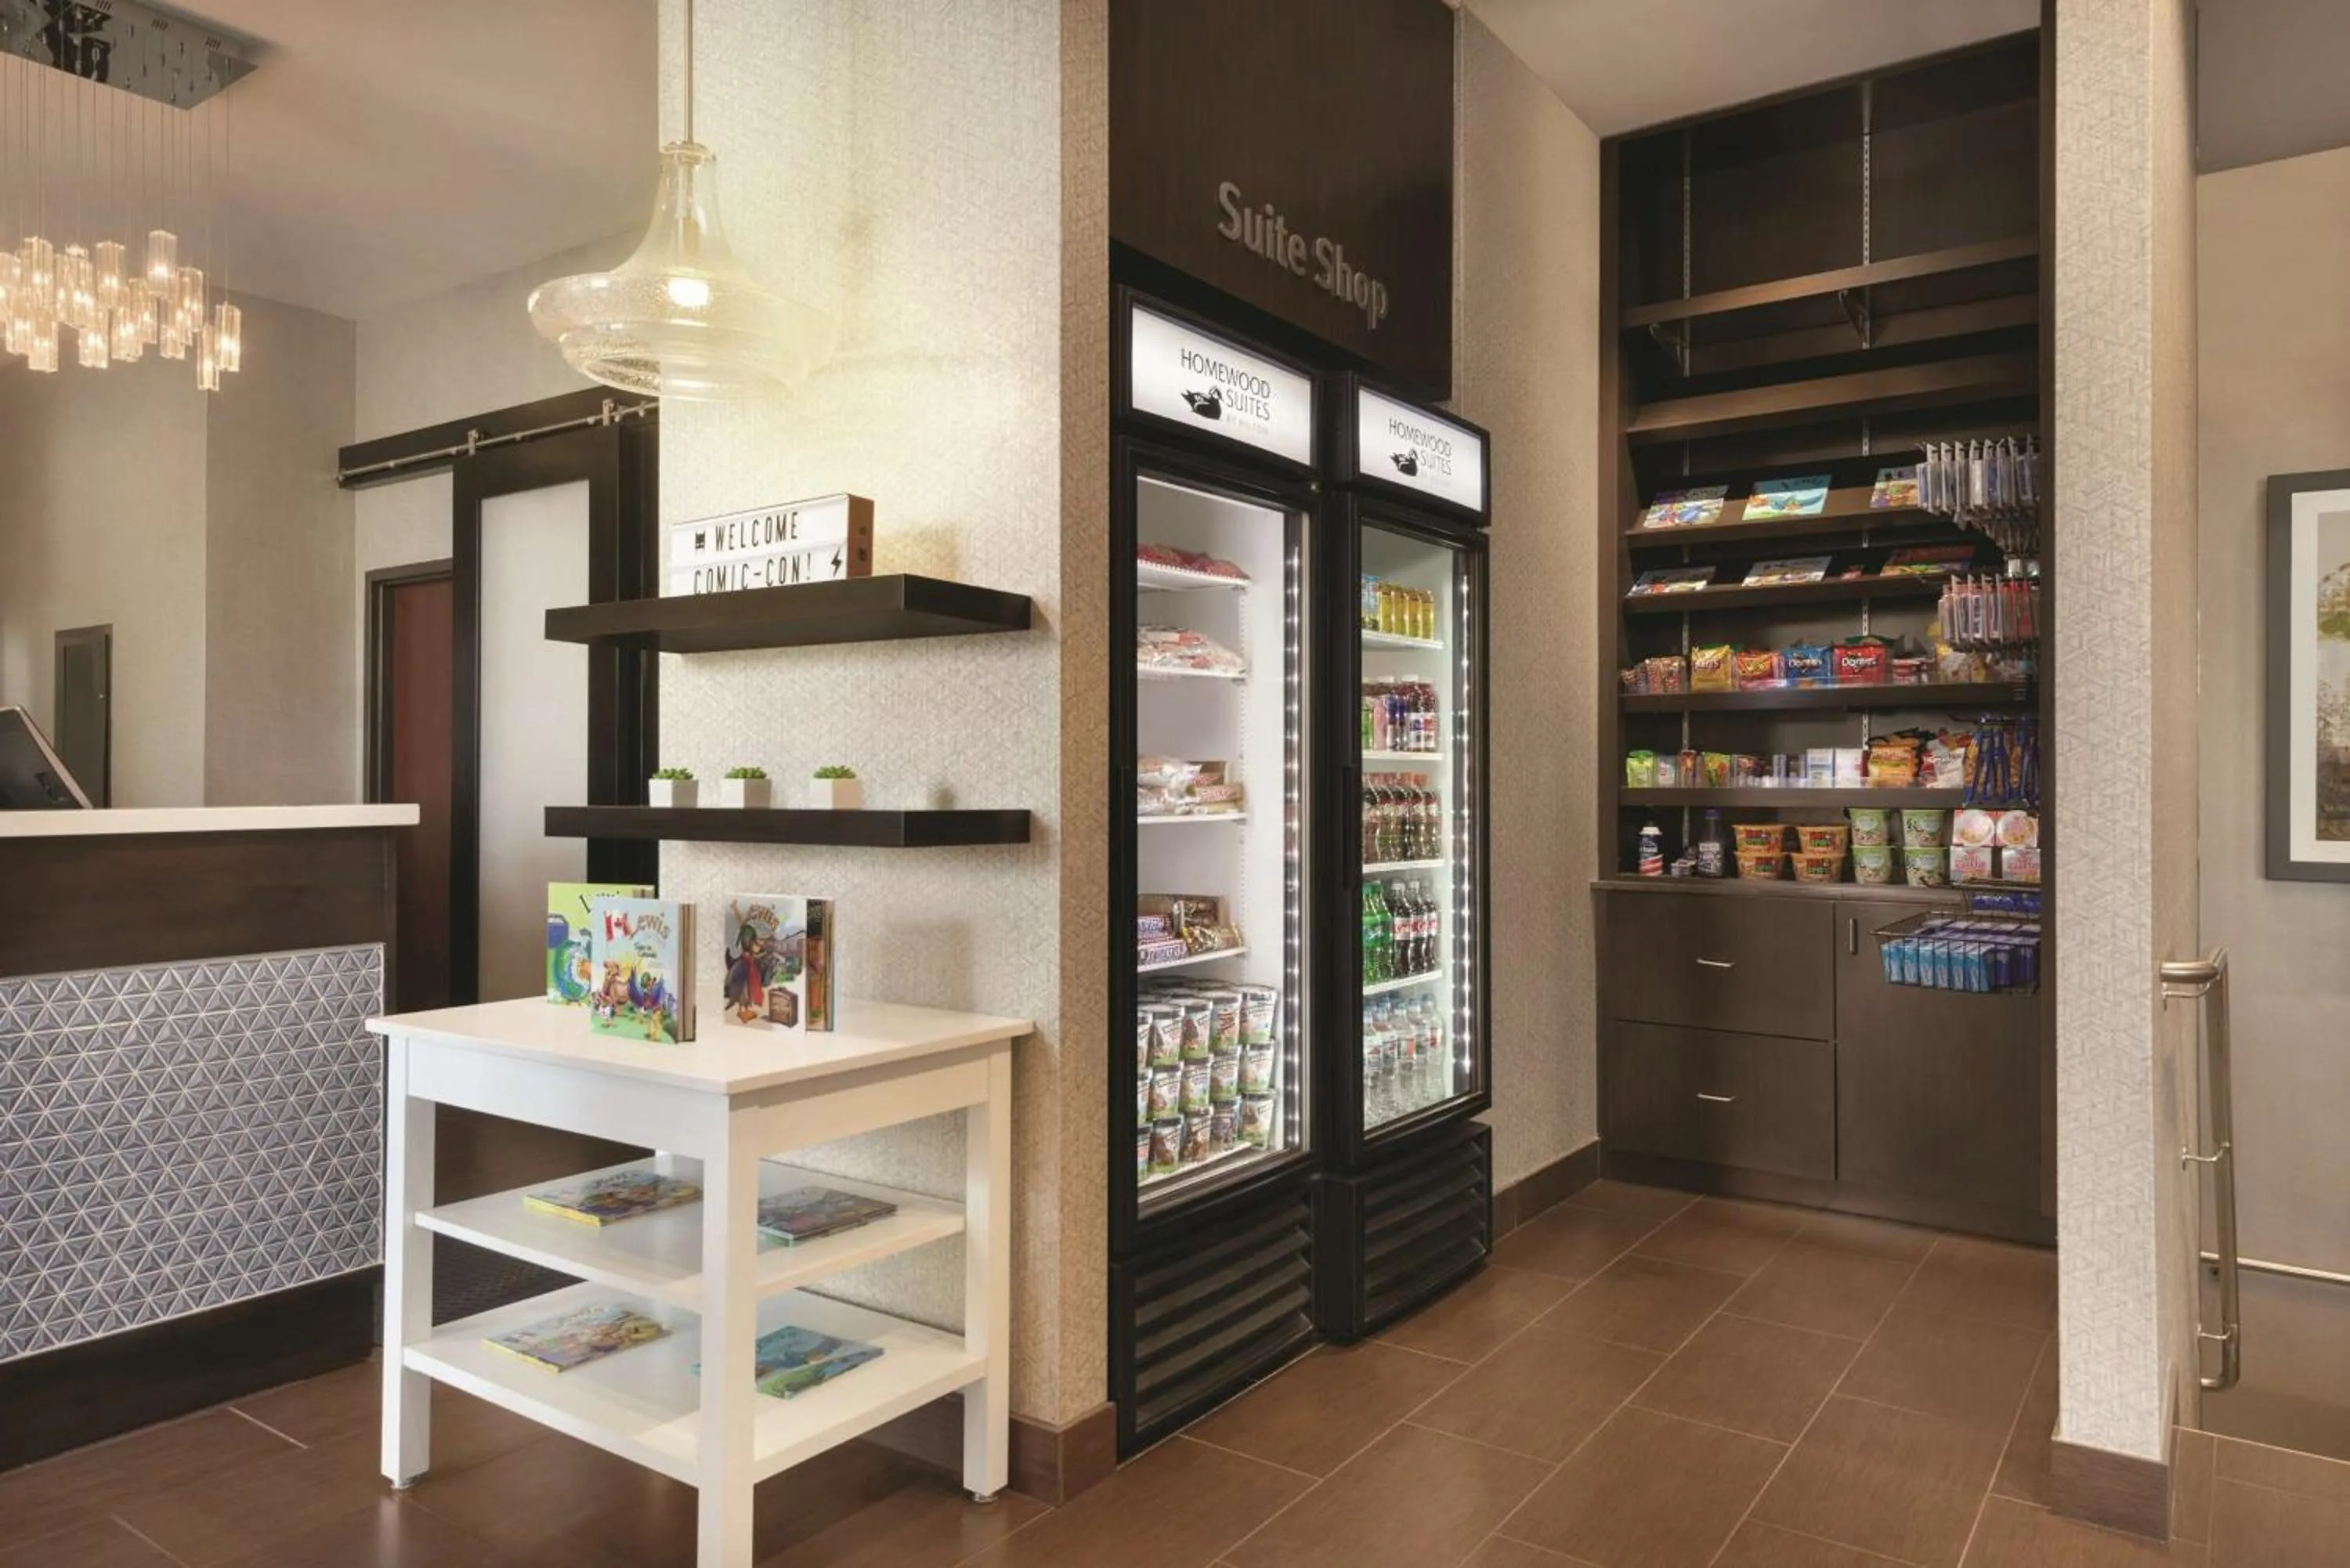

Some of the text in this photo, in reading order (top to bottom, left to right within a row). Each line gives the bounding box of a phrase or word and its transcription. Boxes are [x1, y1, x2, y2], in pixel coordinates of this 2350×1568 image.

[1217, 181, 1388, 330] Suite Shop
[1180, 347, 1271, 399] HOMEWOOD
[1226, 388, 1270, 421] SUITES
[1389, 417, 1452, 457] HOMEWOOD
[1420, 450, 1452, 475] SUITES
[715, 511, 797, 552] WELCOME
[693, 552, 812, 594] COMIC-CON!
